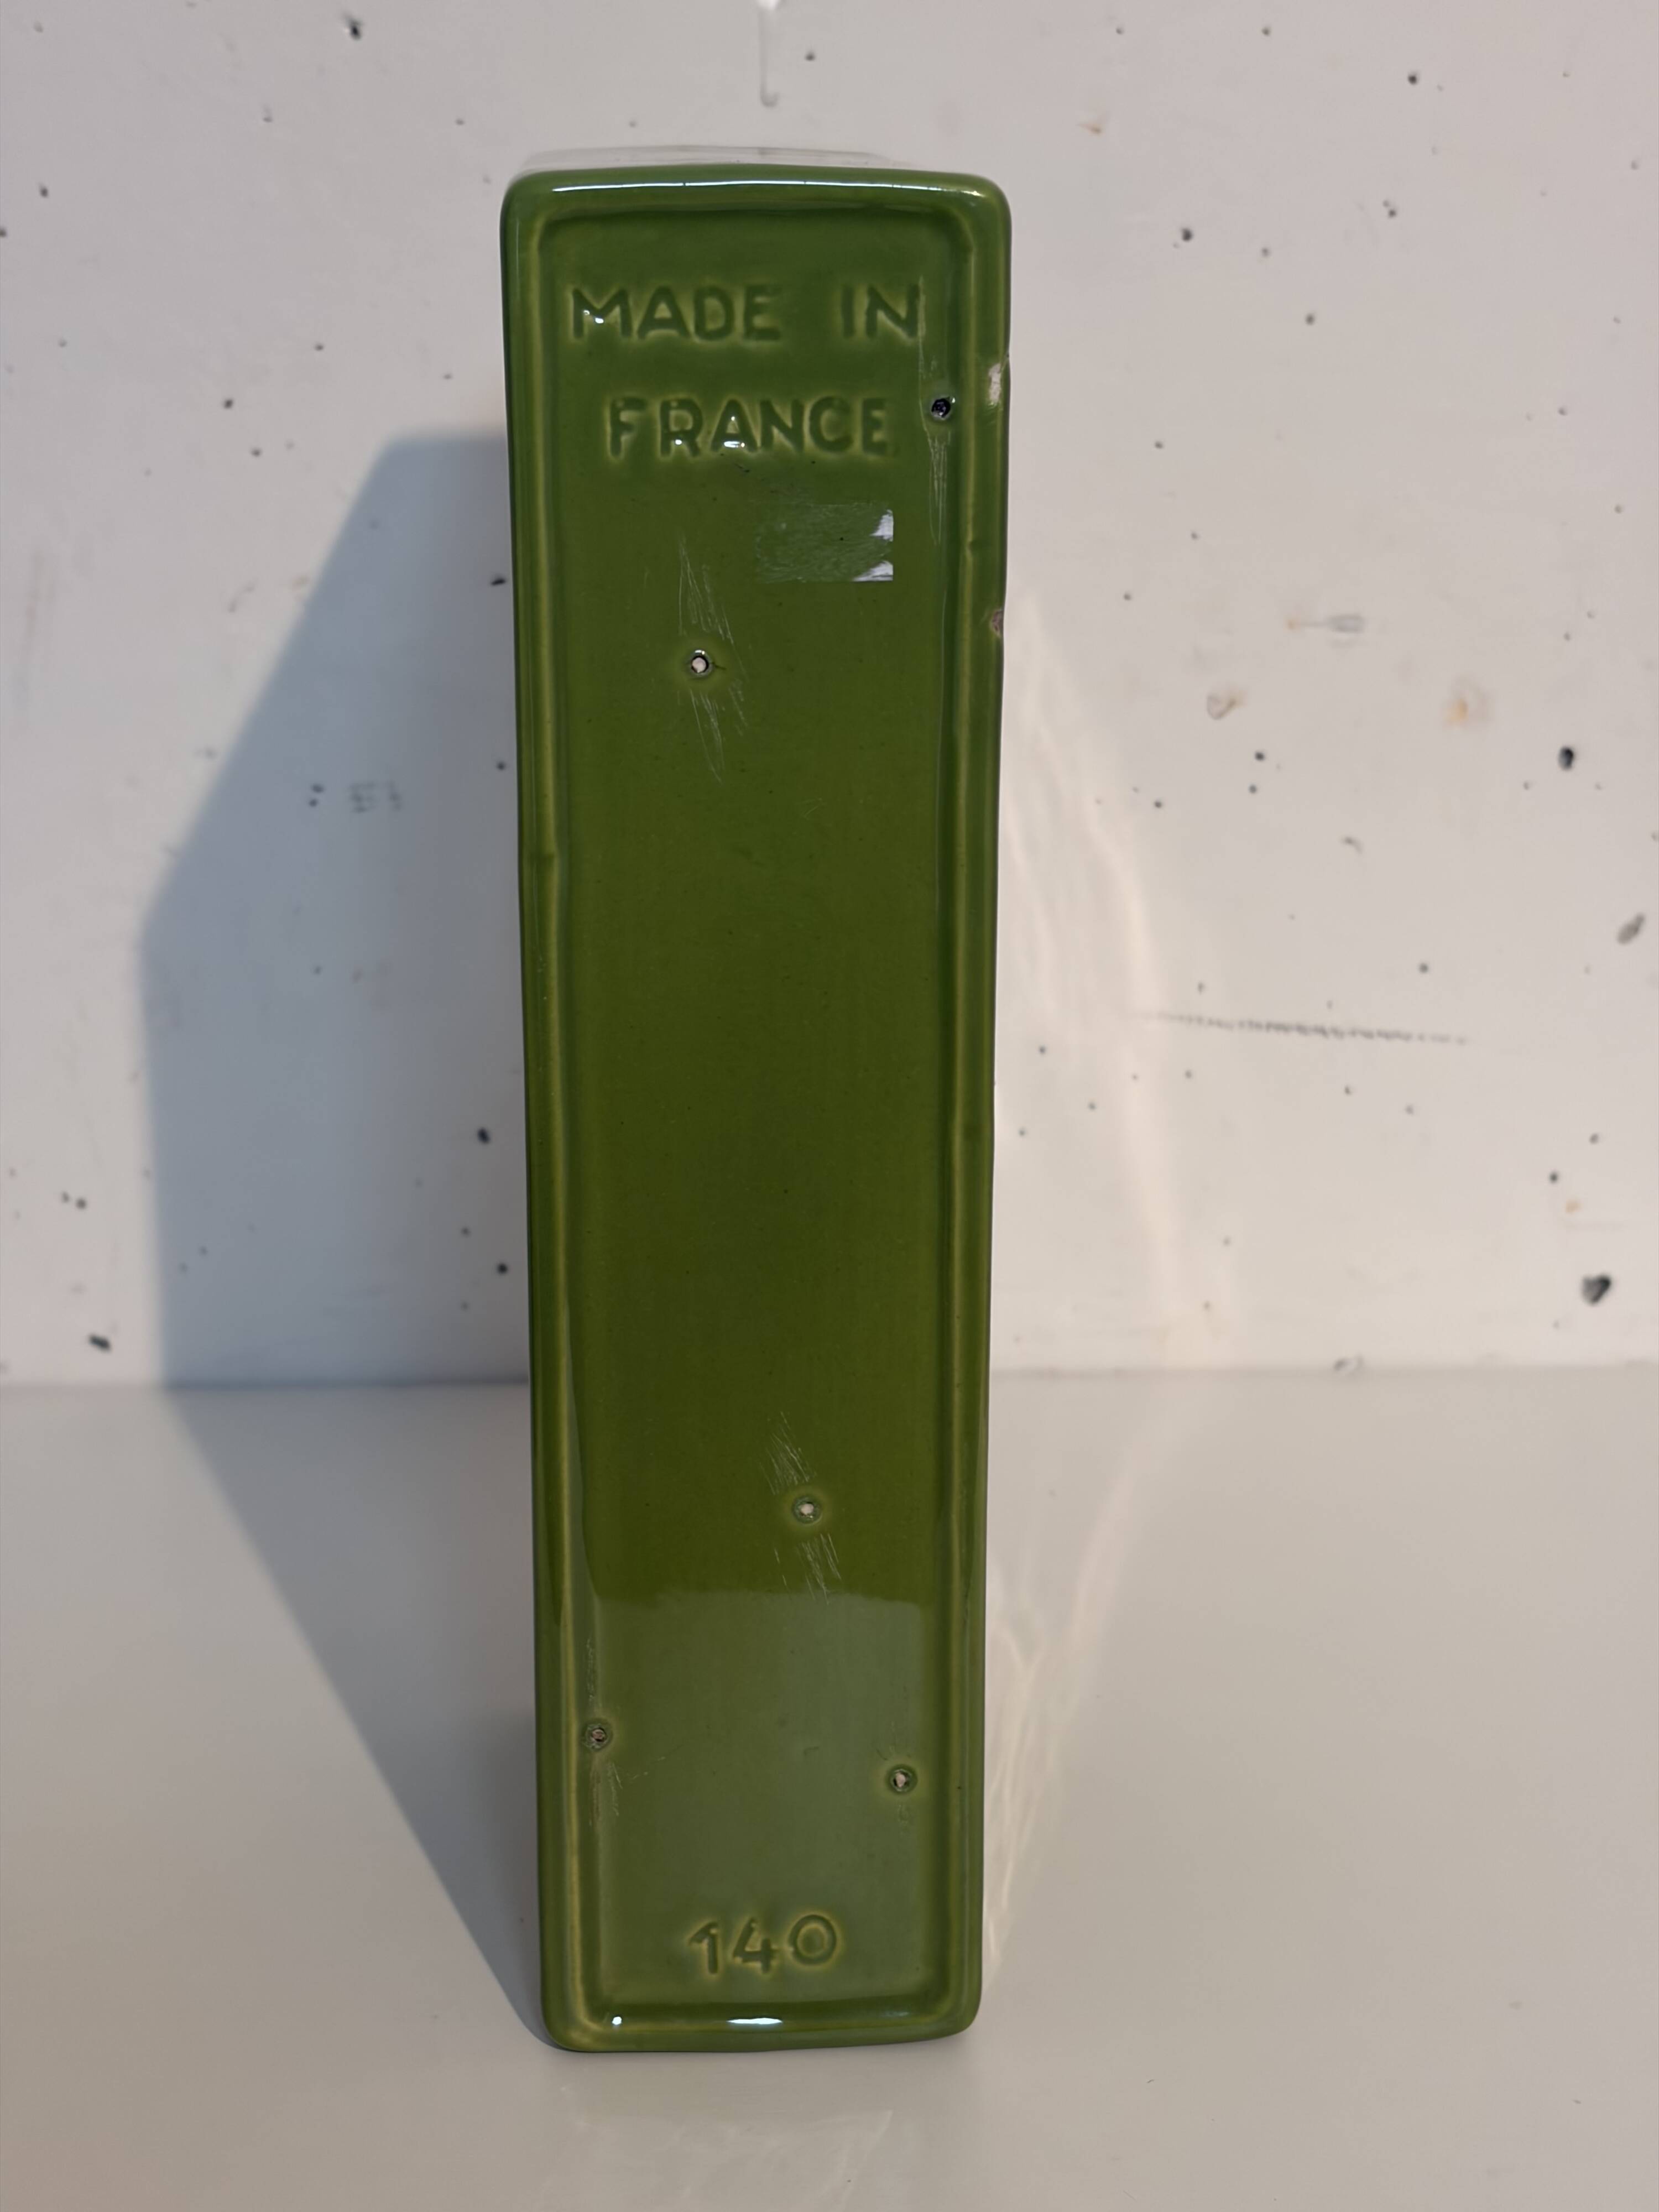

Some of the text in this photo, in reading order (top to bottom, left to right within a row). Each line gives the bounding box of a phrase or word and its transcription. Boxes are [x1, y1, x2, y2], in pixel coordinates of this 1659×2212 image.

[570, 283, 922, 342] MADE IN
[607, 395, 890, 459] FRANCE
[688, 1913, 838, 1975] 140
